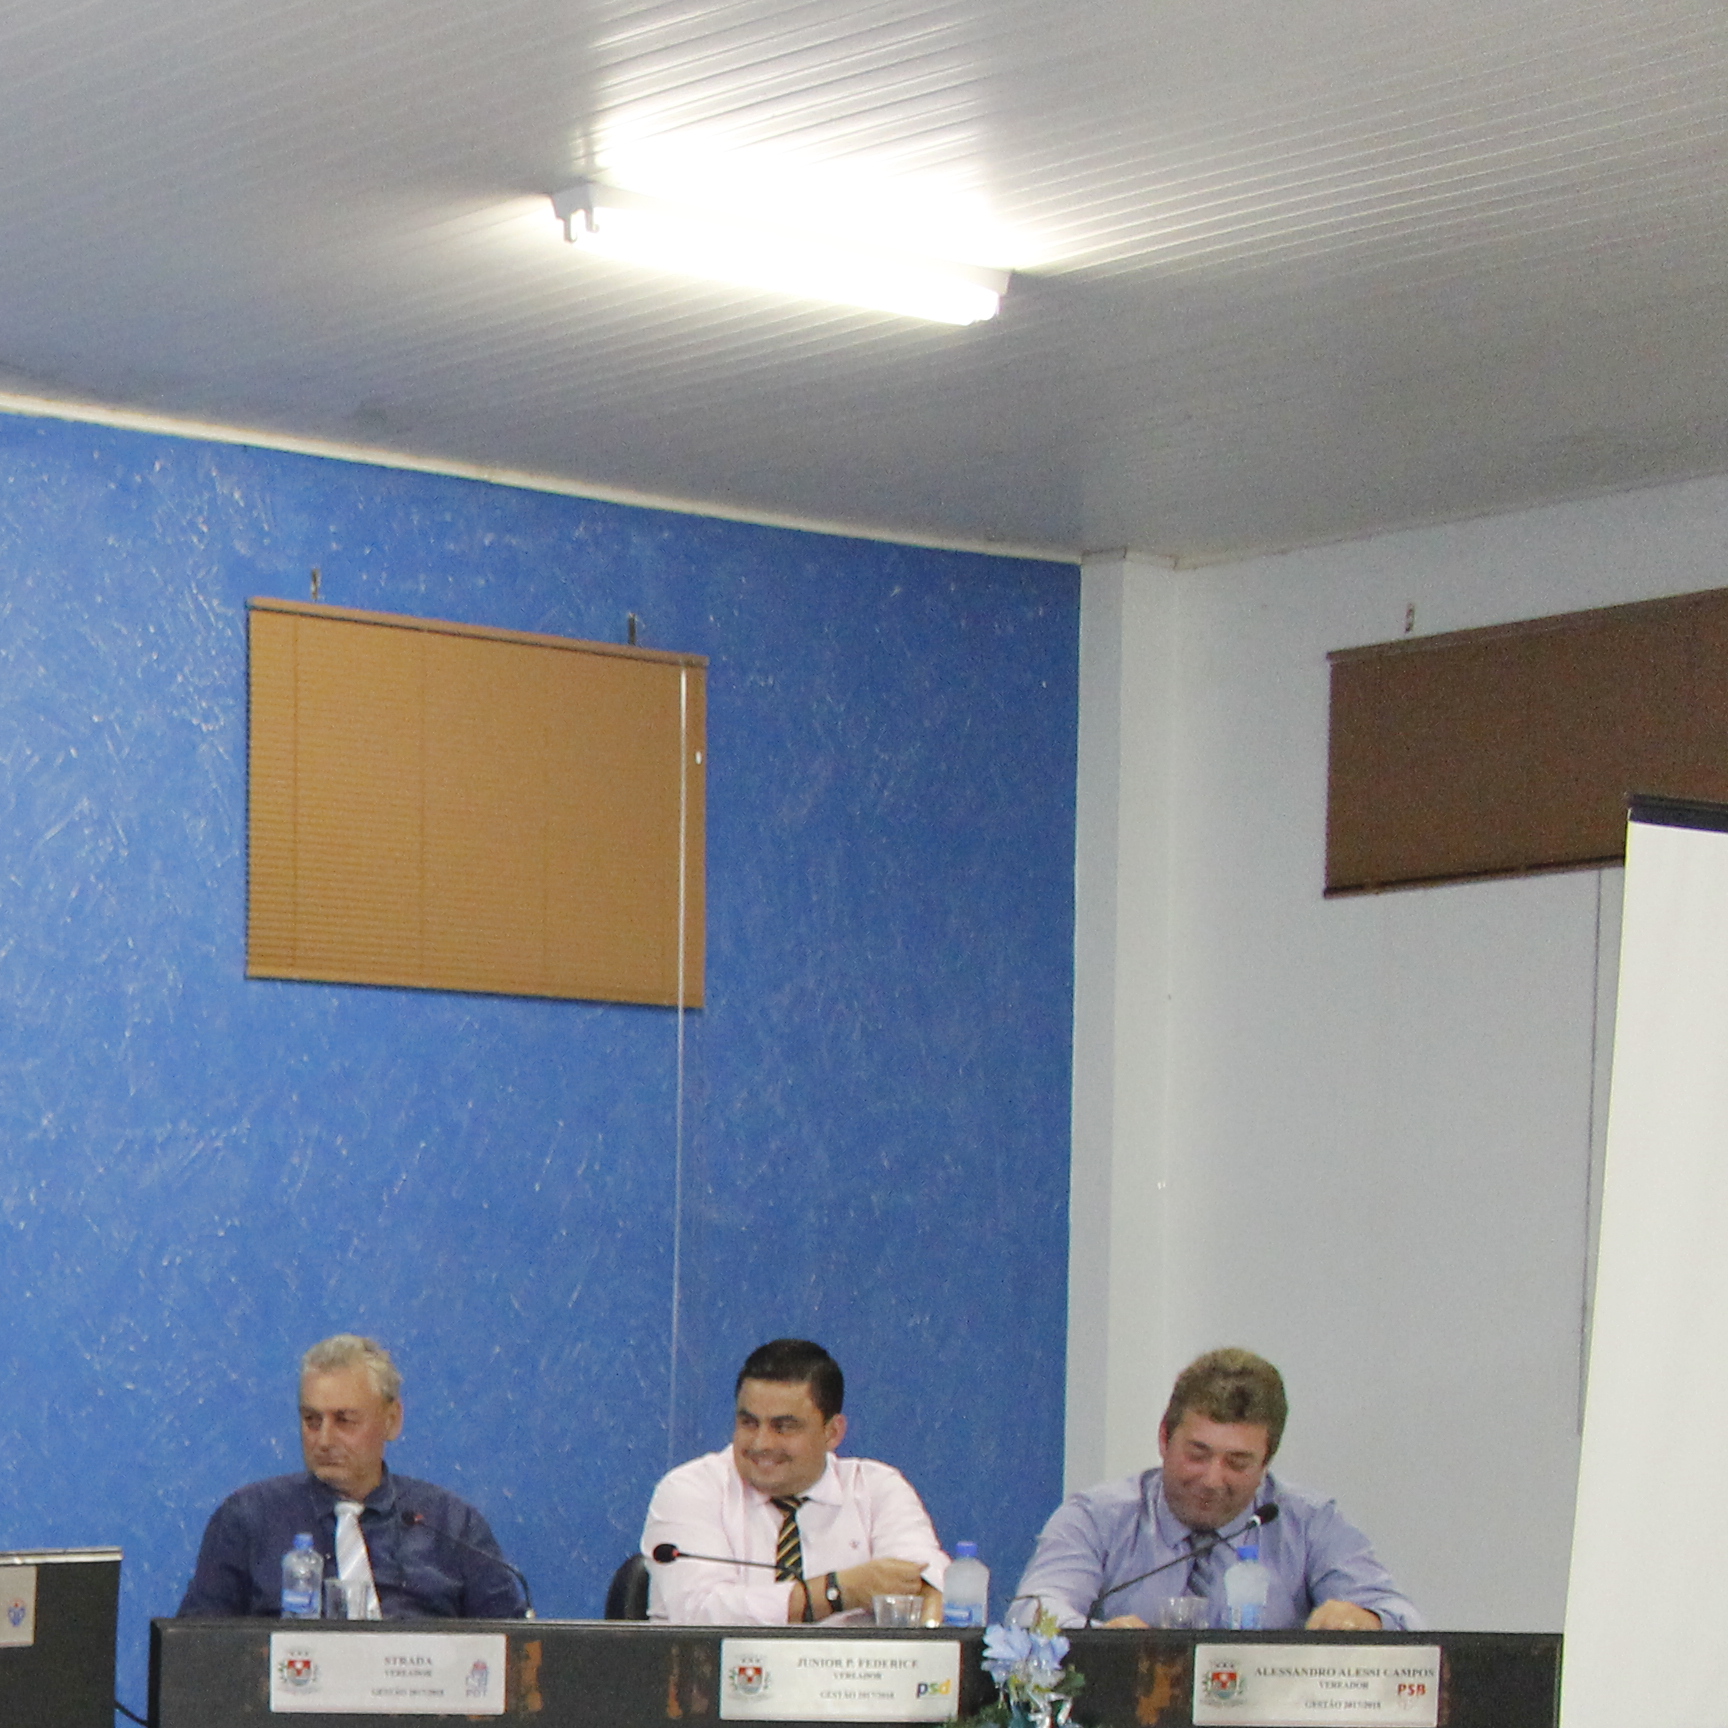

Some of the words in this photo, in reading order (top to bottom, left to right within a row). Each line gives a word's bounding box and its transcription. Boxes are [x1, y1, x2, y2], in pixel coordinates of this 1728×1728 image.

[383, 1655, 433, 1667] STRADA
[797, 1657, 844, 1670] JUNIOR
[383, 1669, 433, 1679] VEREADOR
[832, 1671, 883, 1681] VEREADOR
[1254, 1666, 1337, 1678] ALESSANDRO
[1340, 1667, 1381, 1678] ALESSI
[1382, 1667, 1435, 1679] CAMPOS
[915, 1678, 952, 1699] psd
[1318, 1680, 1370, 1691] VEREADOR
[1396, 1682, 1427, 1697] PSB
[1304, 1698, 1342, 1711] GESTÃO
